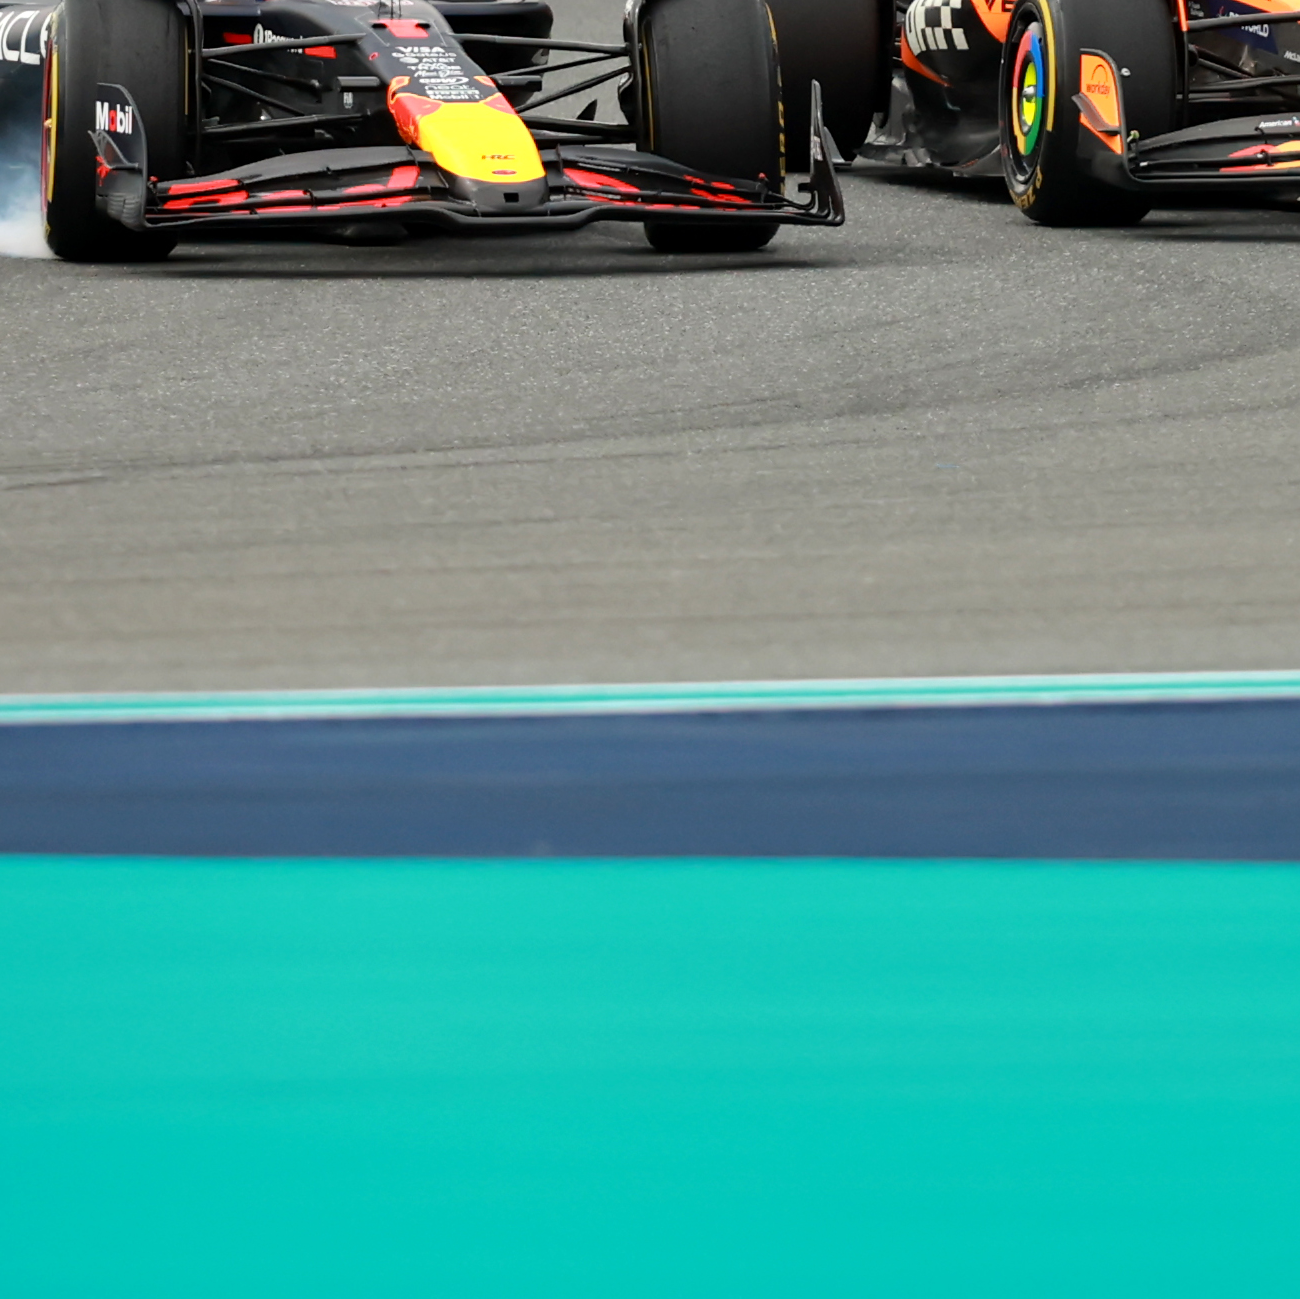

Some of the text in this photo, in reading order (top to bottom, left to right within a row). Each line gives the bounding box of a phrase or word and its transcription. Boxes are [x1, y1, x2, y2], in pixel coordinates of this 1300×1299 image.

[1086, 82, 1111, 98] workday
[96, 101, 132, 135] Mobil
[1259, 120, 1293, 129] American
